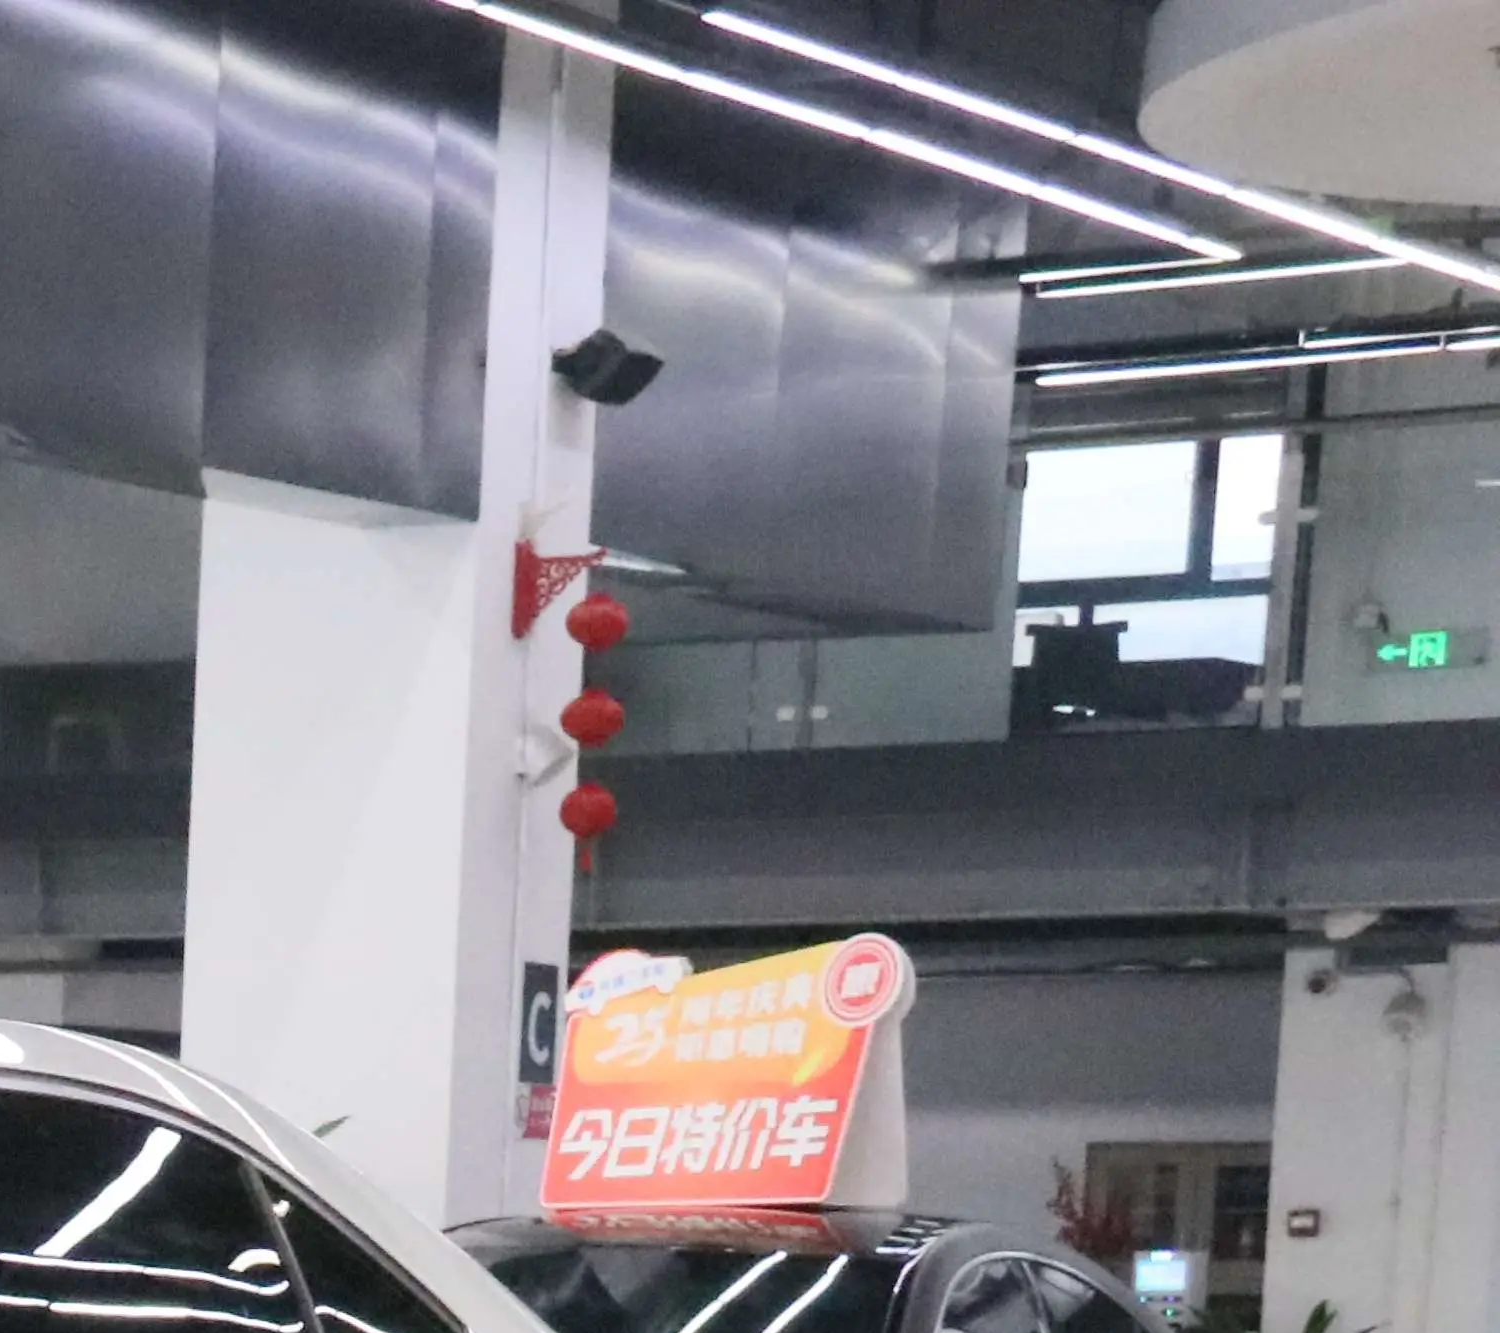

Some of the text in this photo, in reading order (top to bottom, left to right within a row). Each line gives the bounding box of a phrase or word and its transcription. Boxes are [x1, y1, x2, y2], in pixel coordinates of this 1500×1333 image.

[529, 991, 552, 1066] C
[560, 1095, 838, 1180] 今日特价车
